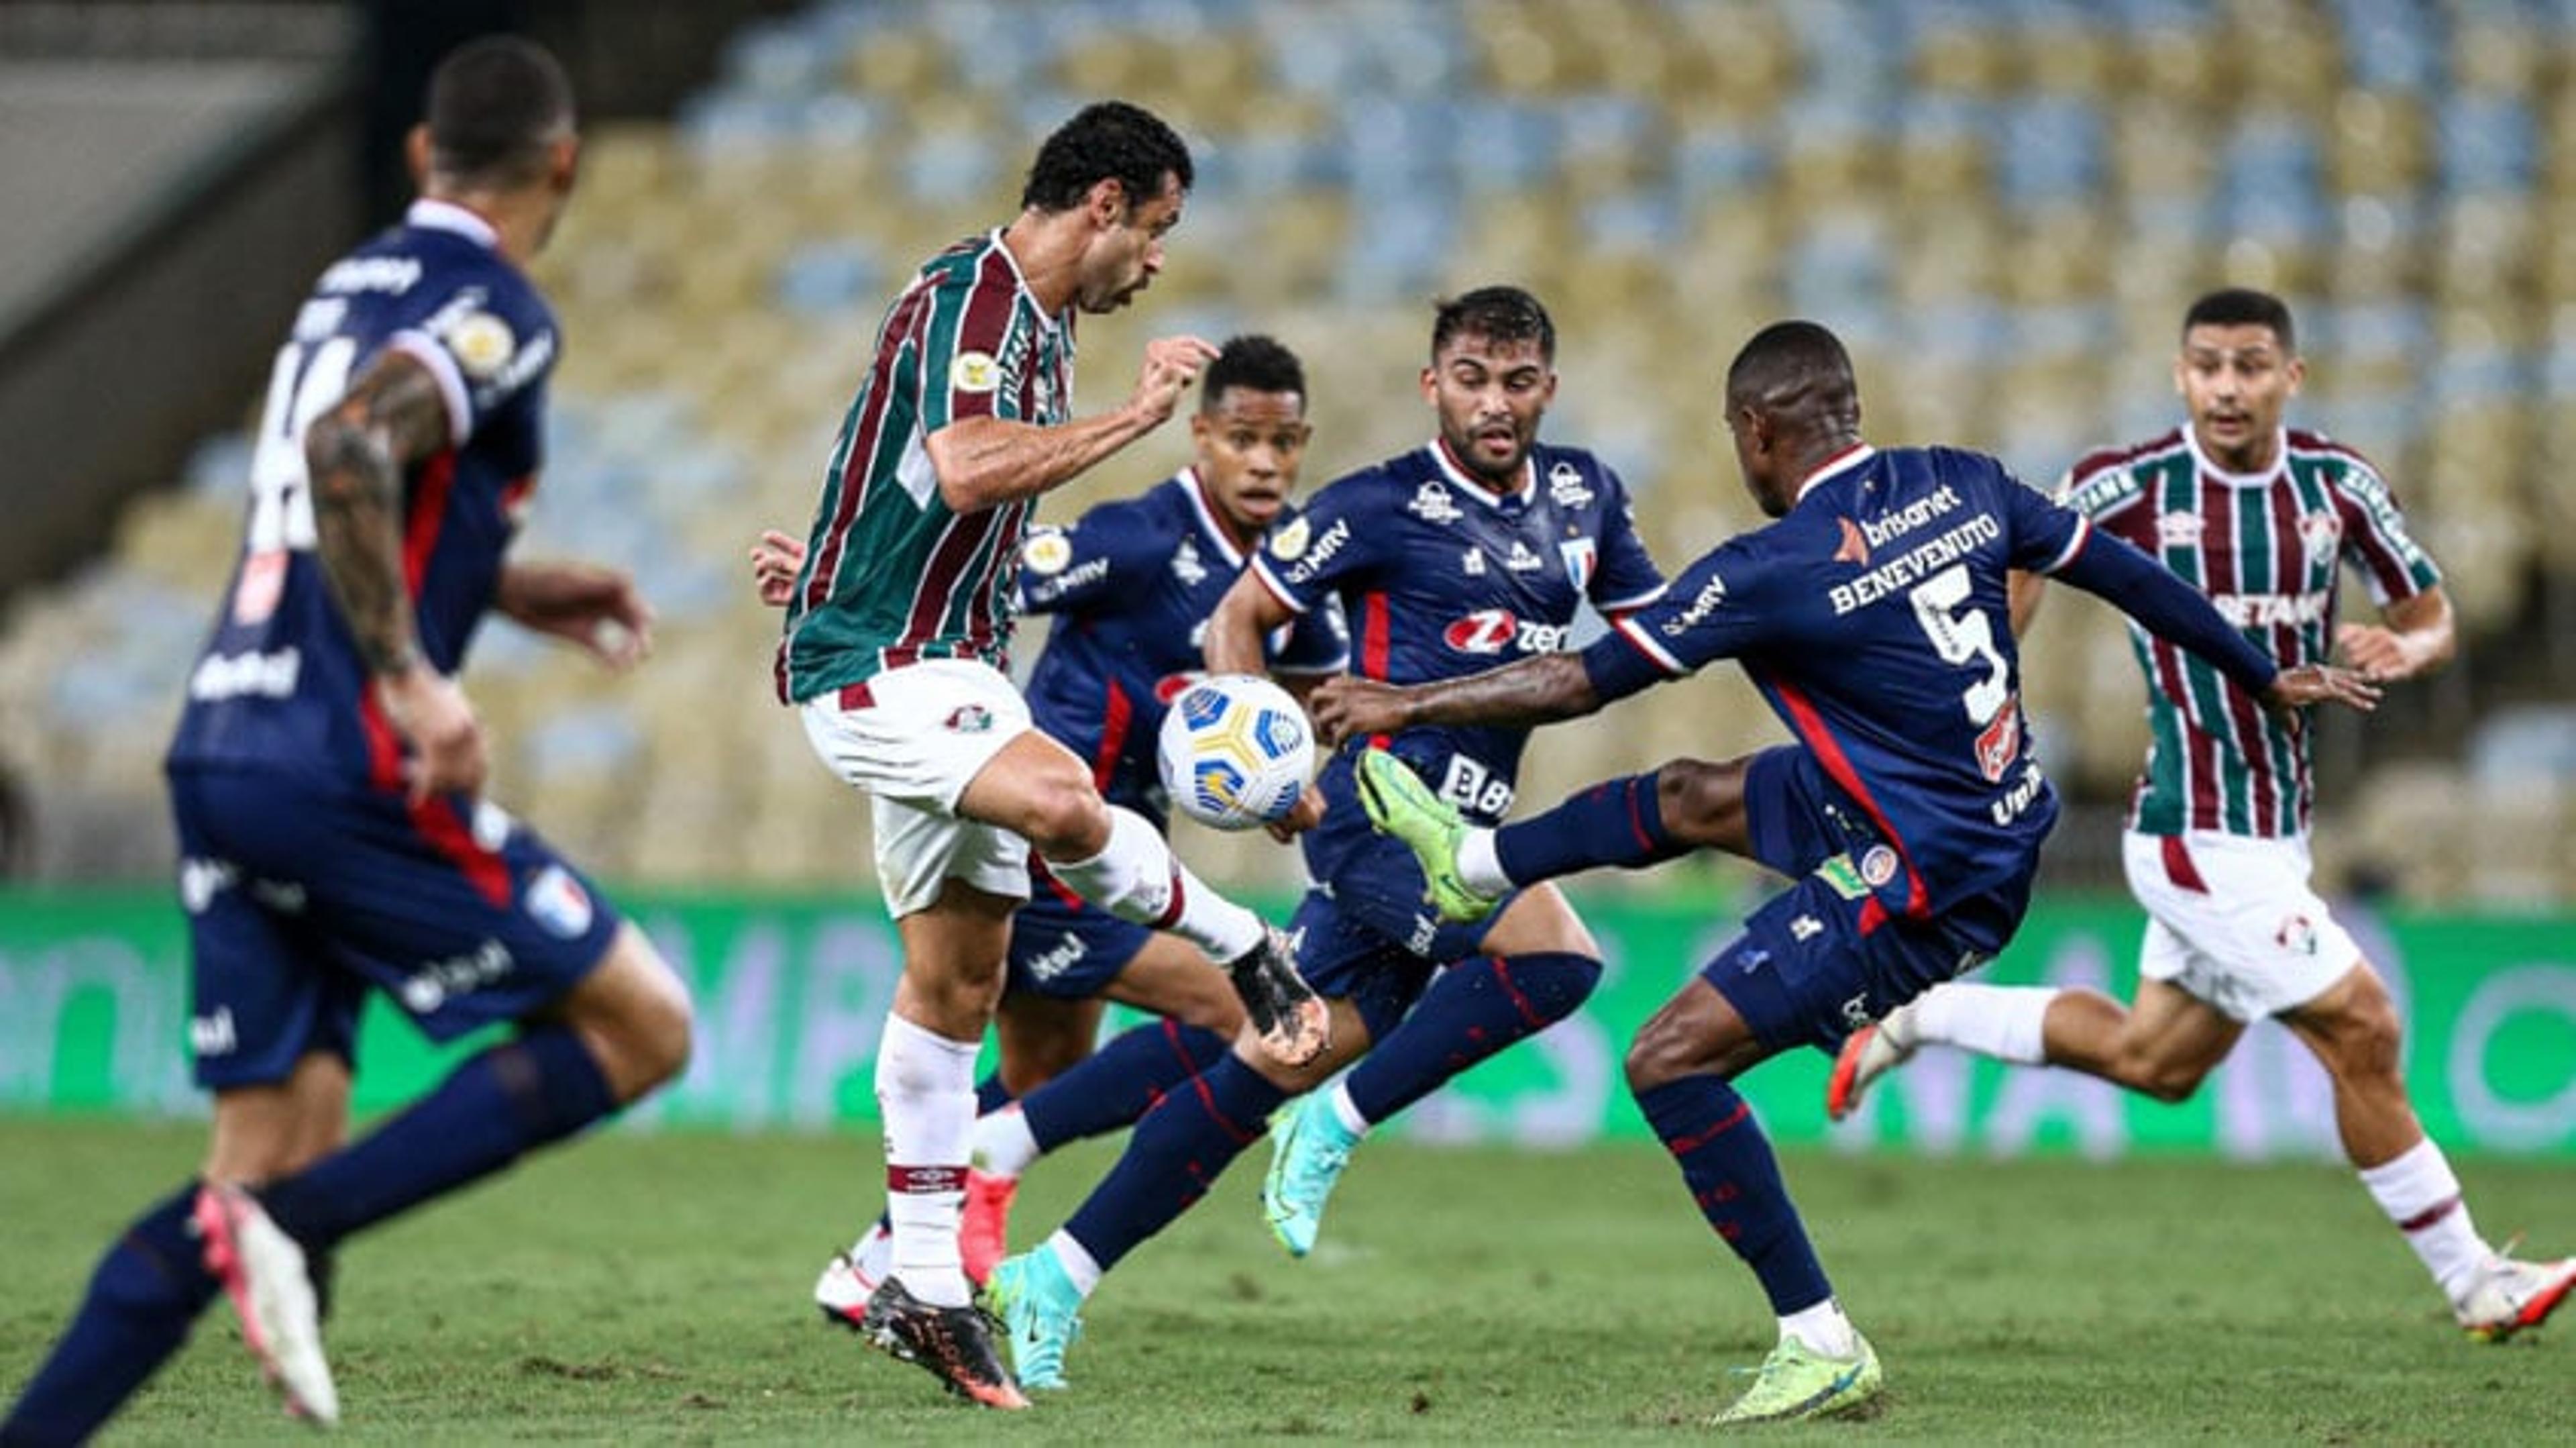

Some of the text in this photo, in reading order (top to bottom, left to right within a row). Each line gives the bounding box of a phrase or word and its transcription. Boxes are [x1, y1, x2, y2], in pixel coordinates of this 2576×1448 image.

[1304, 518, 1350, 570] MRV
[1860, 484, 1963, 548] brisanet
[1828, 513, 2000, 615] BENEVENUTO
[1681, 574, 1727, 625] MRV
[1909, 564, 2007, 726] 5
